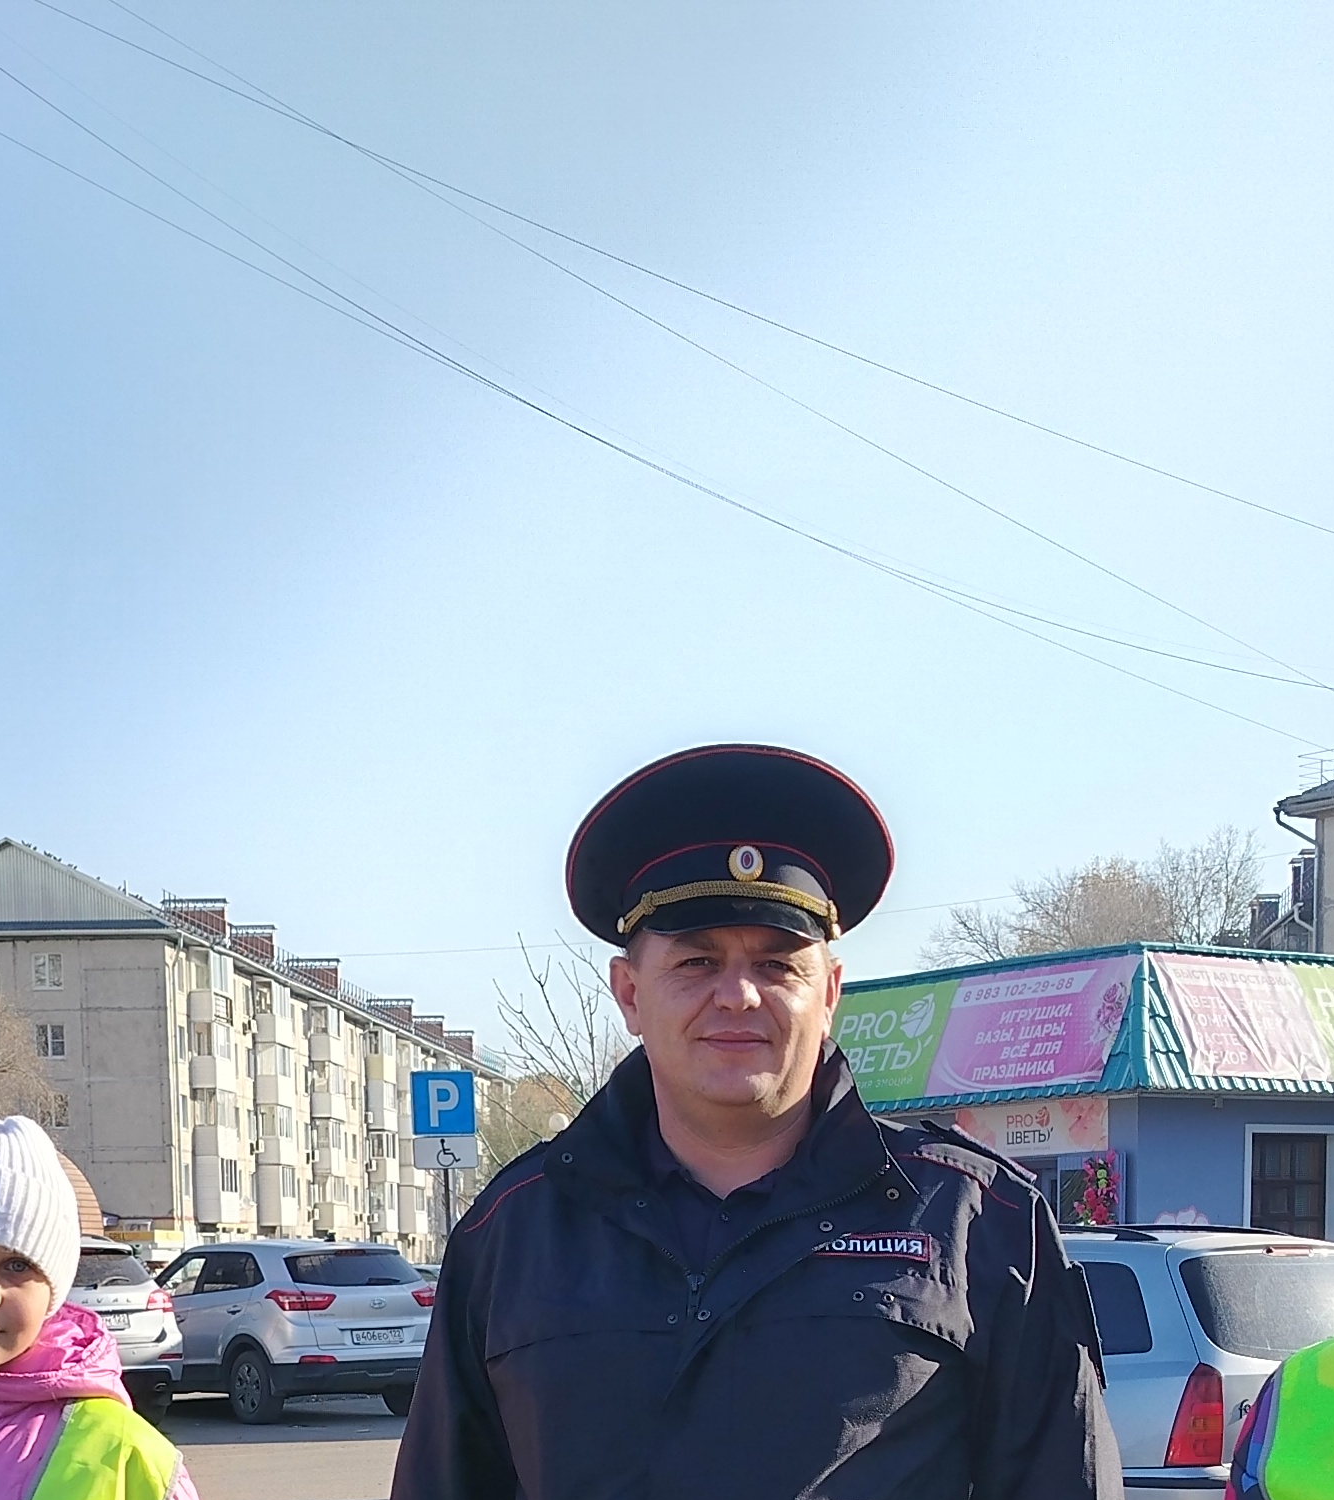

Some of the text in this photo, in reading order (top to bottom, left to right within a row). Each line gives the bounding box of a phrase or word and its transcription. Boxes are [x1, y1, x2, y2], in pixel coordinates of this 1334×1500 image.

[1230, 972, 1291, 986] ДОСТАВКА
[963, 977, 1074, 1002] 8 983 102-29-88
[836, 1010, 897, 1042] PRO
[1030, 1040, 1063, 1057] ДЛЯ
[972, 1060, 1054, 1081] ПРАЗДНИКА
[429, 1080, 459, 1127] P
[1006, 1113, 1033, 1128] PRO
[826, 1238, 922, 1254] ОЛИЦИЯ
